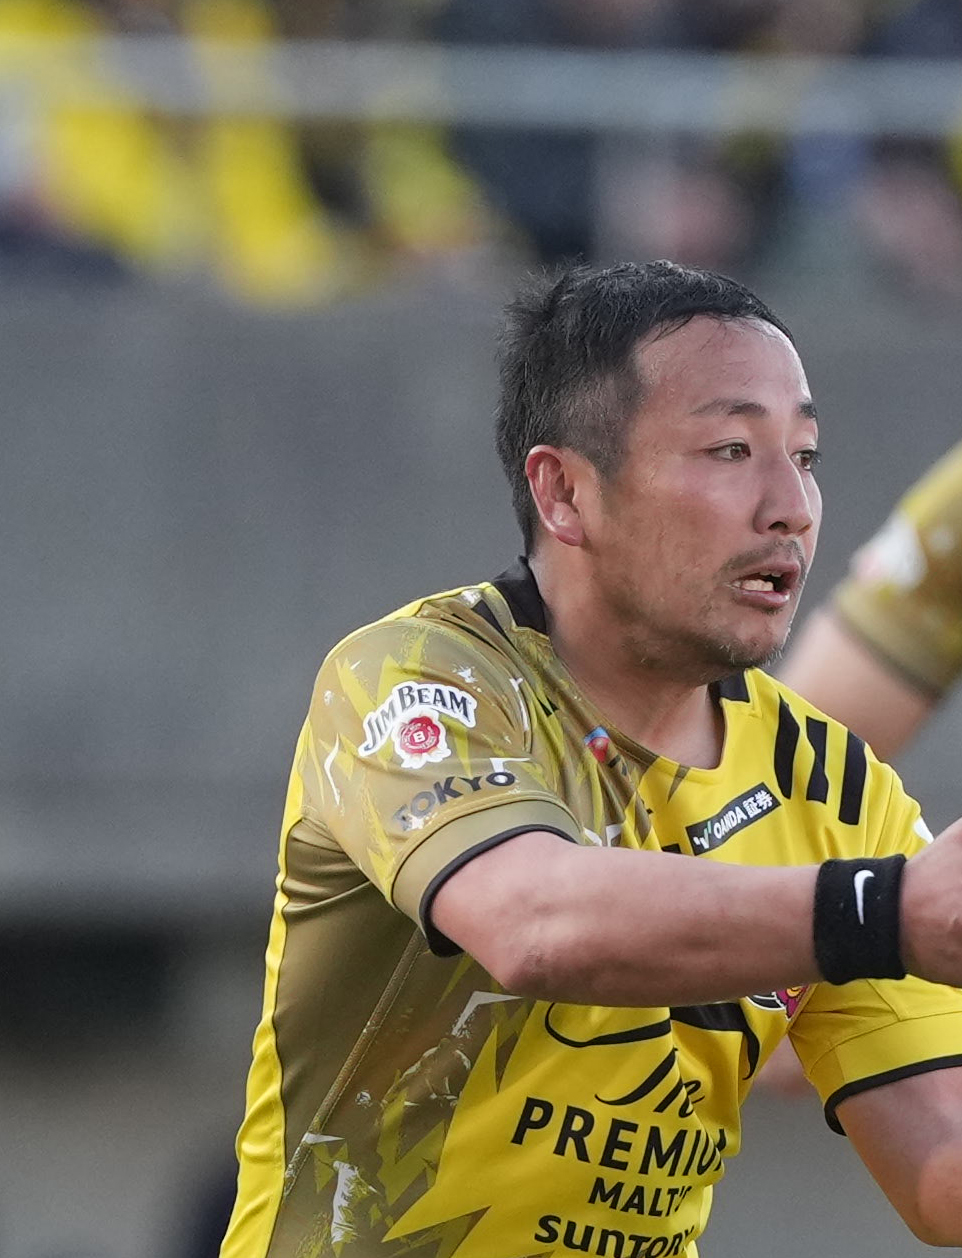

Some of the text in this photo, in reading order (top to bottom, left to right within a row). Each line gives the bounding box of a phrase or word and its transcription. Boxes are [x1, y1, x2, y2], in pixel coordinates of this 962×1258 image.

[363, 684, 472, 752] JIM BEAM
[393, 771, 516, 832] TOKYO
